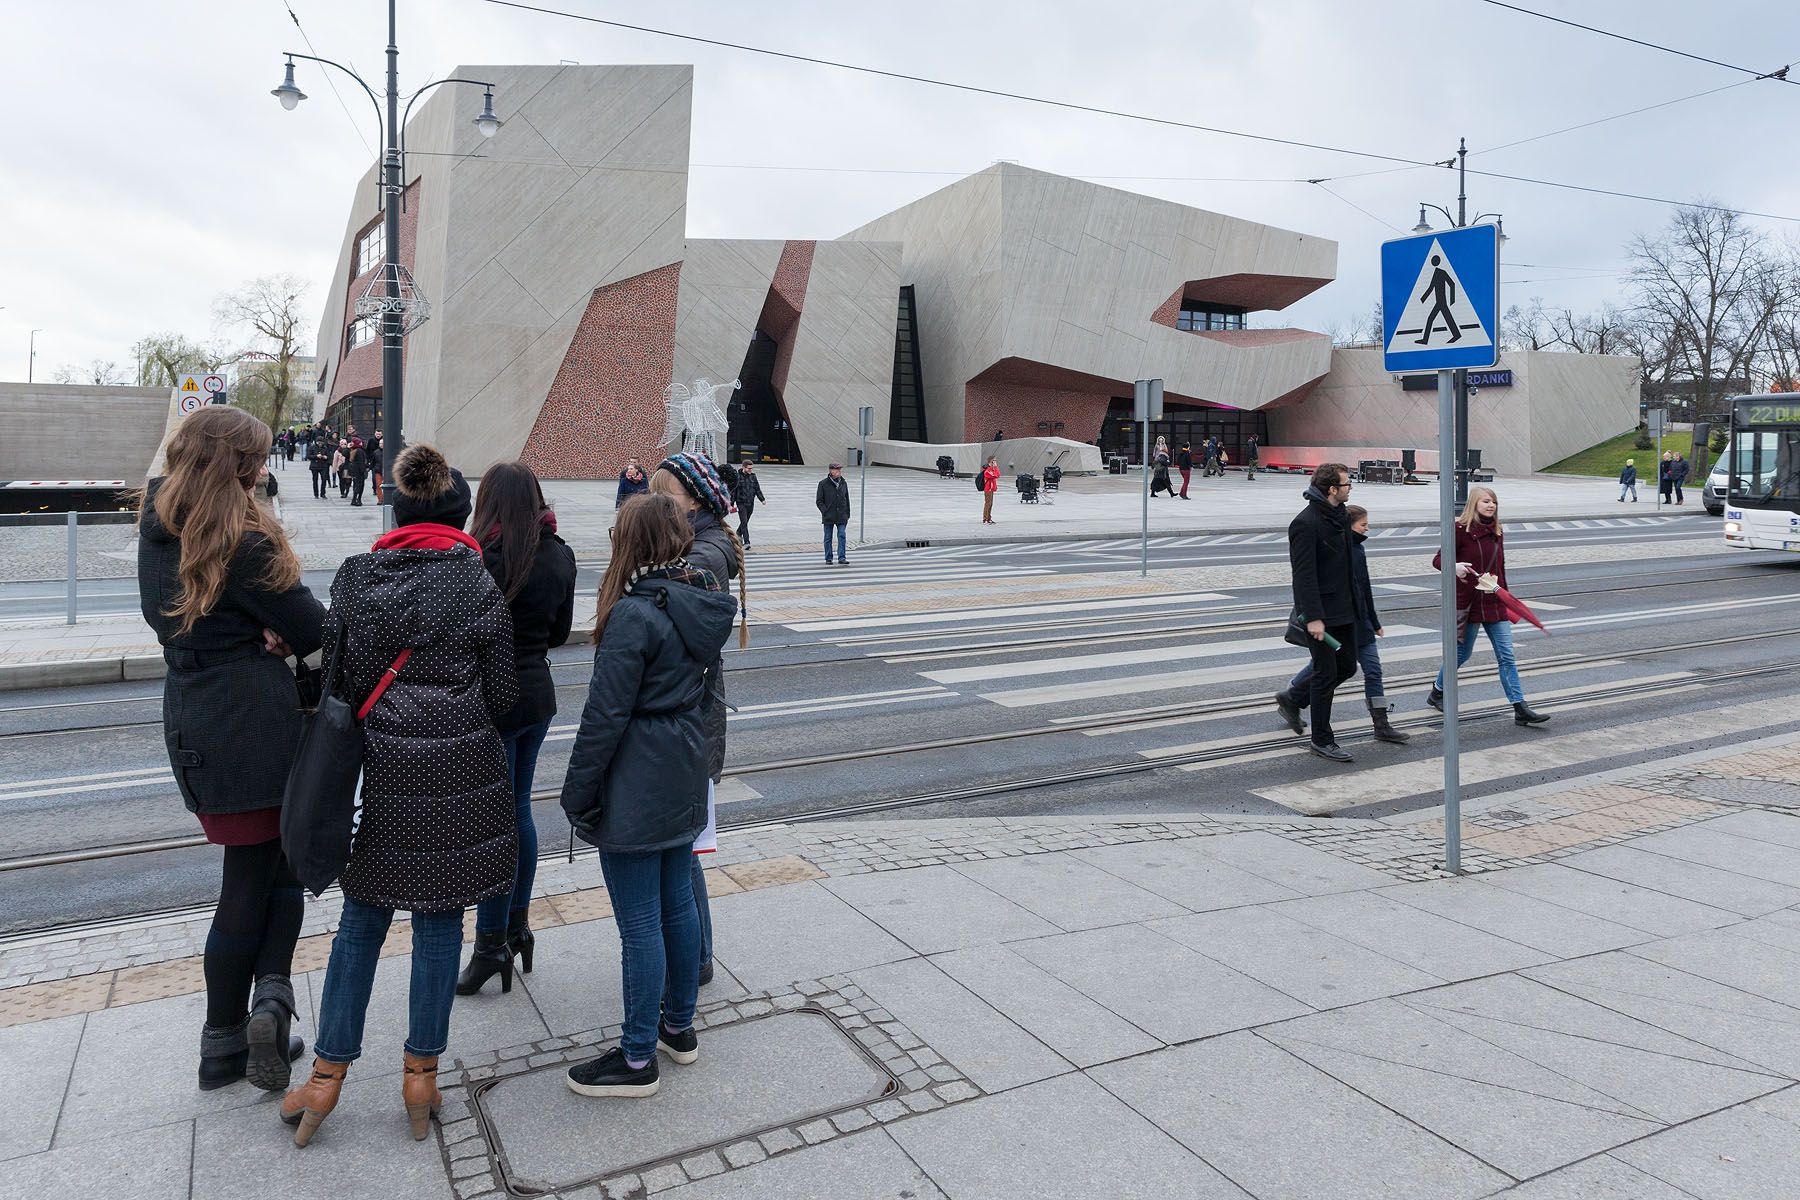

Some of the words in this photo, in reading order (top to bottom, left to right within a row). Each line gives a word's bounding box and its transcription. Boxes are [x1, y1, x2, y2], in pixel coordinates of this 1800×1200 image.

[1466, 373, 1509, 385] RDANKI
[188, 400, 195, 410] 5
[1750, 407, 1772, 423] 22
